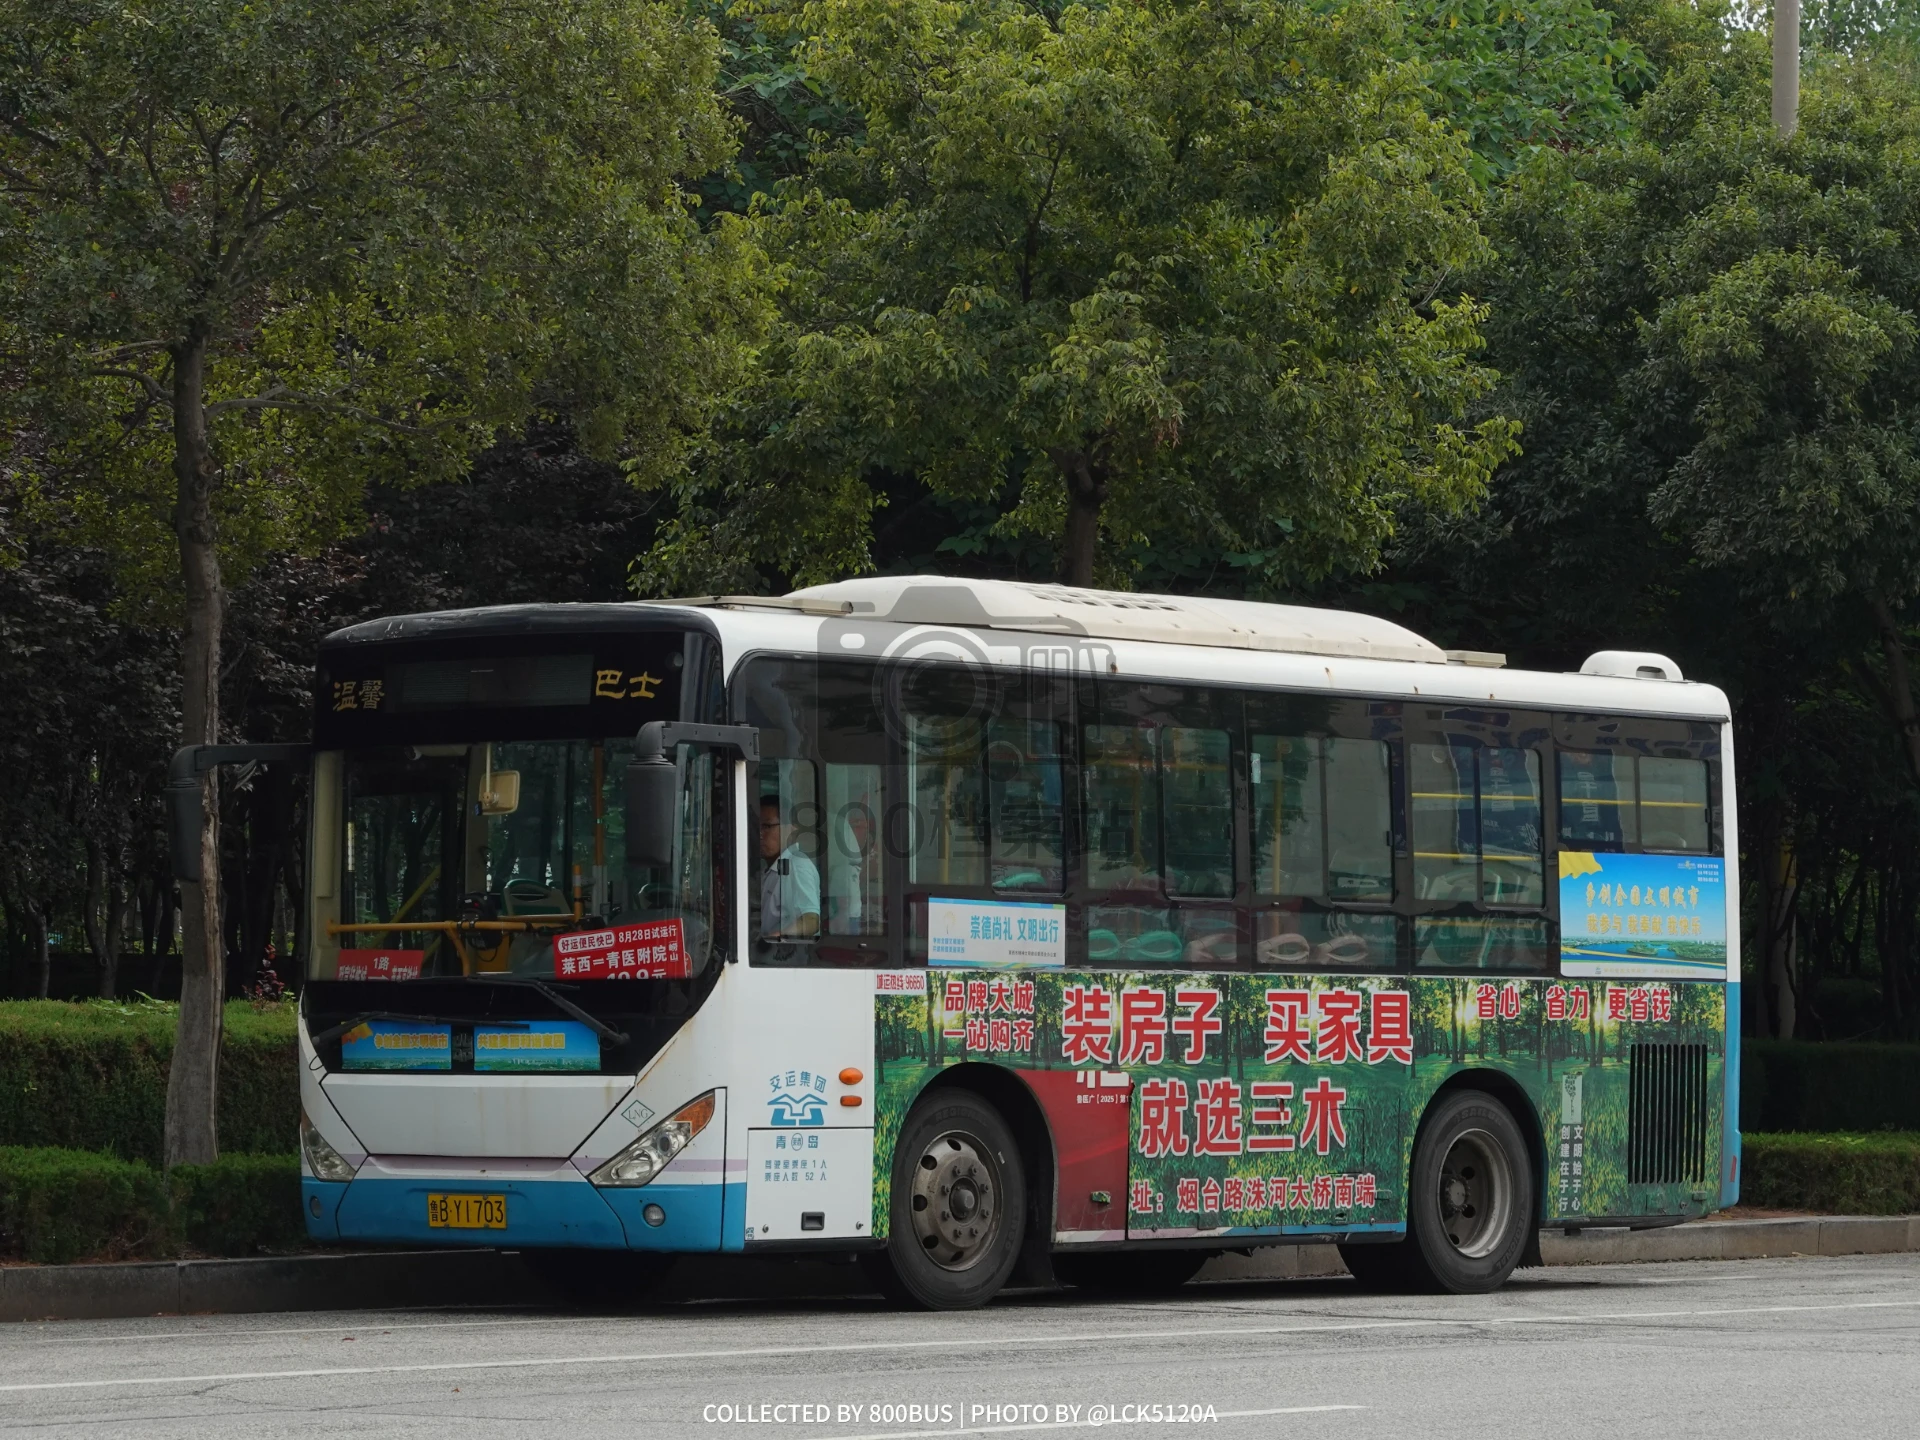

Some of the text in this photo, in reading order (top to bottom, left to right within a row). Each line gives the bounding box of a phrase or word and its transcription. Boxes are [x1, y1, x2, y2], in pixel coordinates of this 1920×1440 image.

[332, 668, 664, 713] 温馨 巴士
[561, 924, 678, 951] 好运便民快巴 8月28日试运行
[970, 915, 1059, 943] 崇德尚礼 文明出行
[373, 956, 389, 971] 1路
[944, 981, 1034, 1014] 品牌大城
[1476, 984, 1672, 1023] 省心 省力 更省钱
[943, 1019, 1034, 1052] 一站购齐
[1062, 985, 1413, 1066] 装房子 买家具
[768, 1070, 827, 1094] 交运集团
[1139, 1077, 1347, 1159] 就选三木
[805, 1172, 814, 1181] 52
[820, 1172, 827, 1181] 人
[812, 1159, 816, 1169] 1
[820, 1159, 827, 1169] 人
[1559, 1125, 1571, 1212] 创建在于行
[1571, 1125, 1584, 1211] 文明始于心
[1177, 1173, 1376, 1213] 烟台路洙河大桥南端
